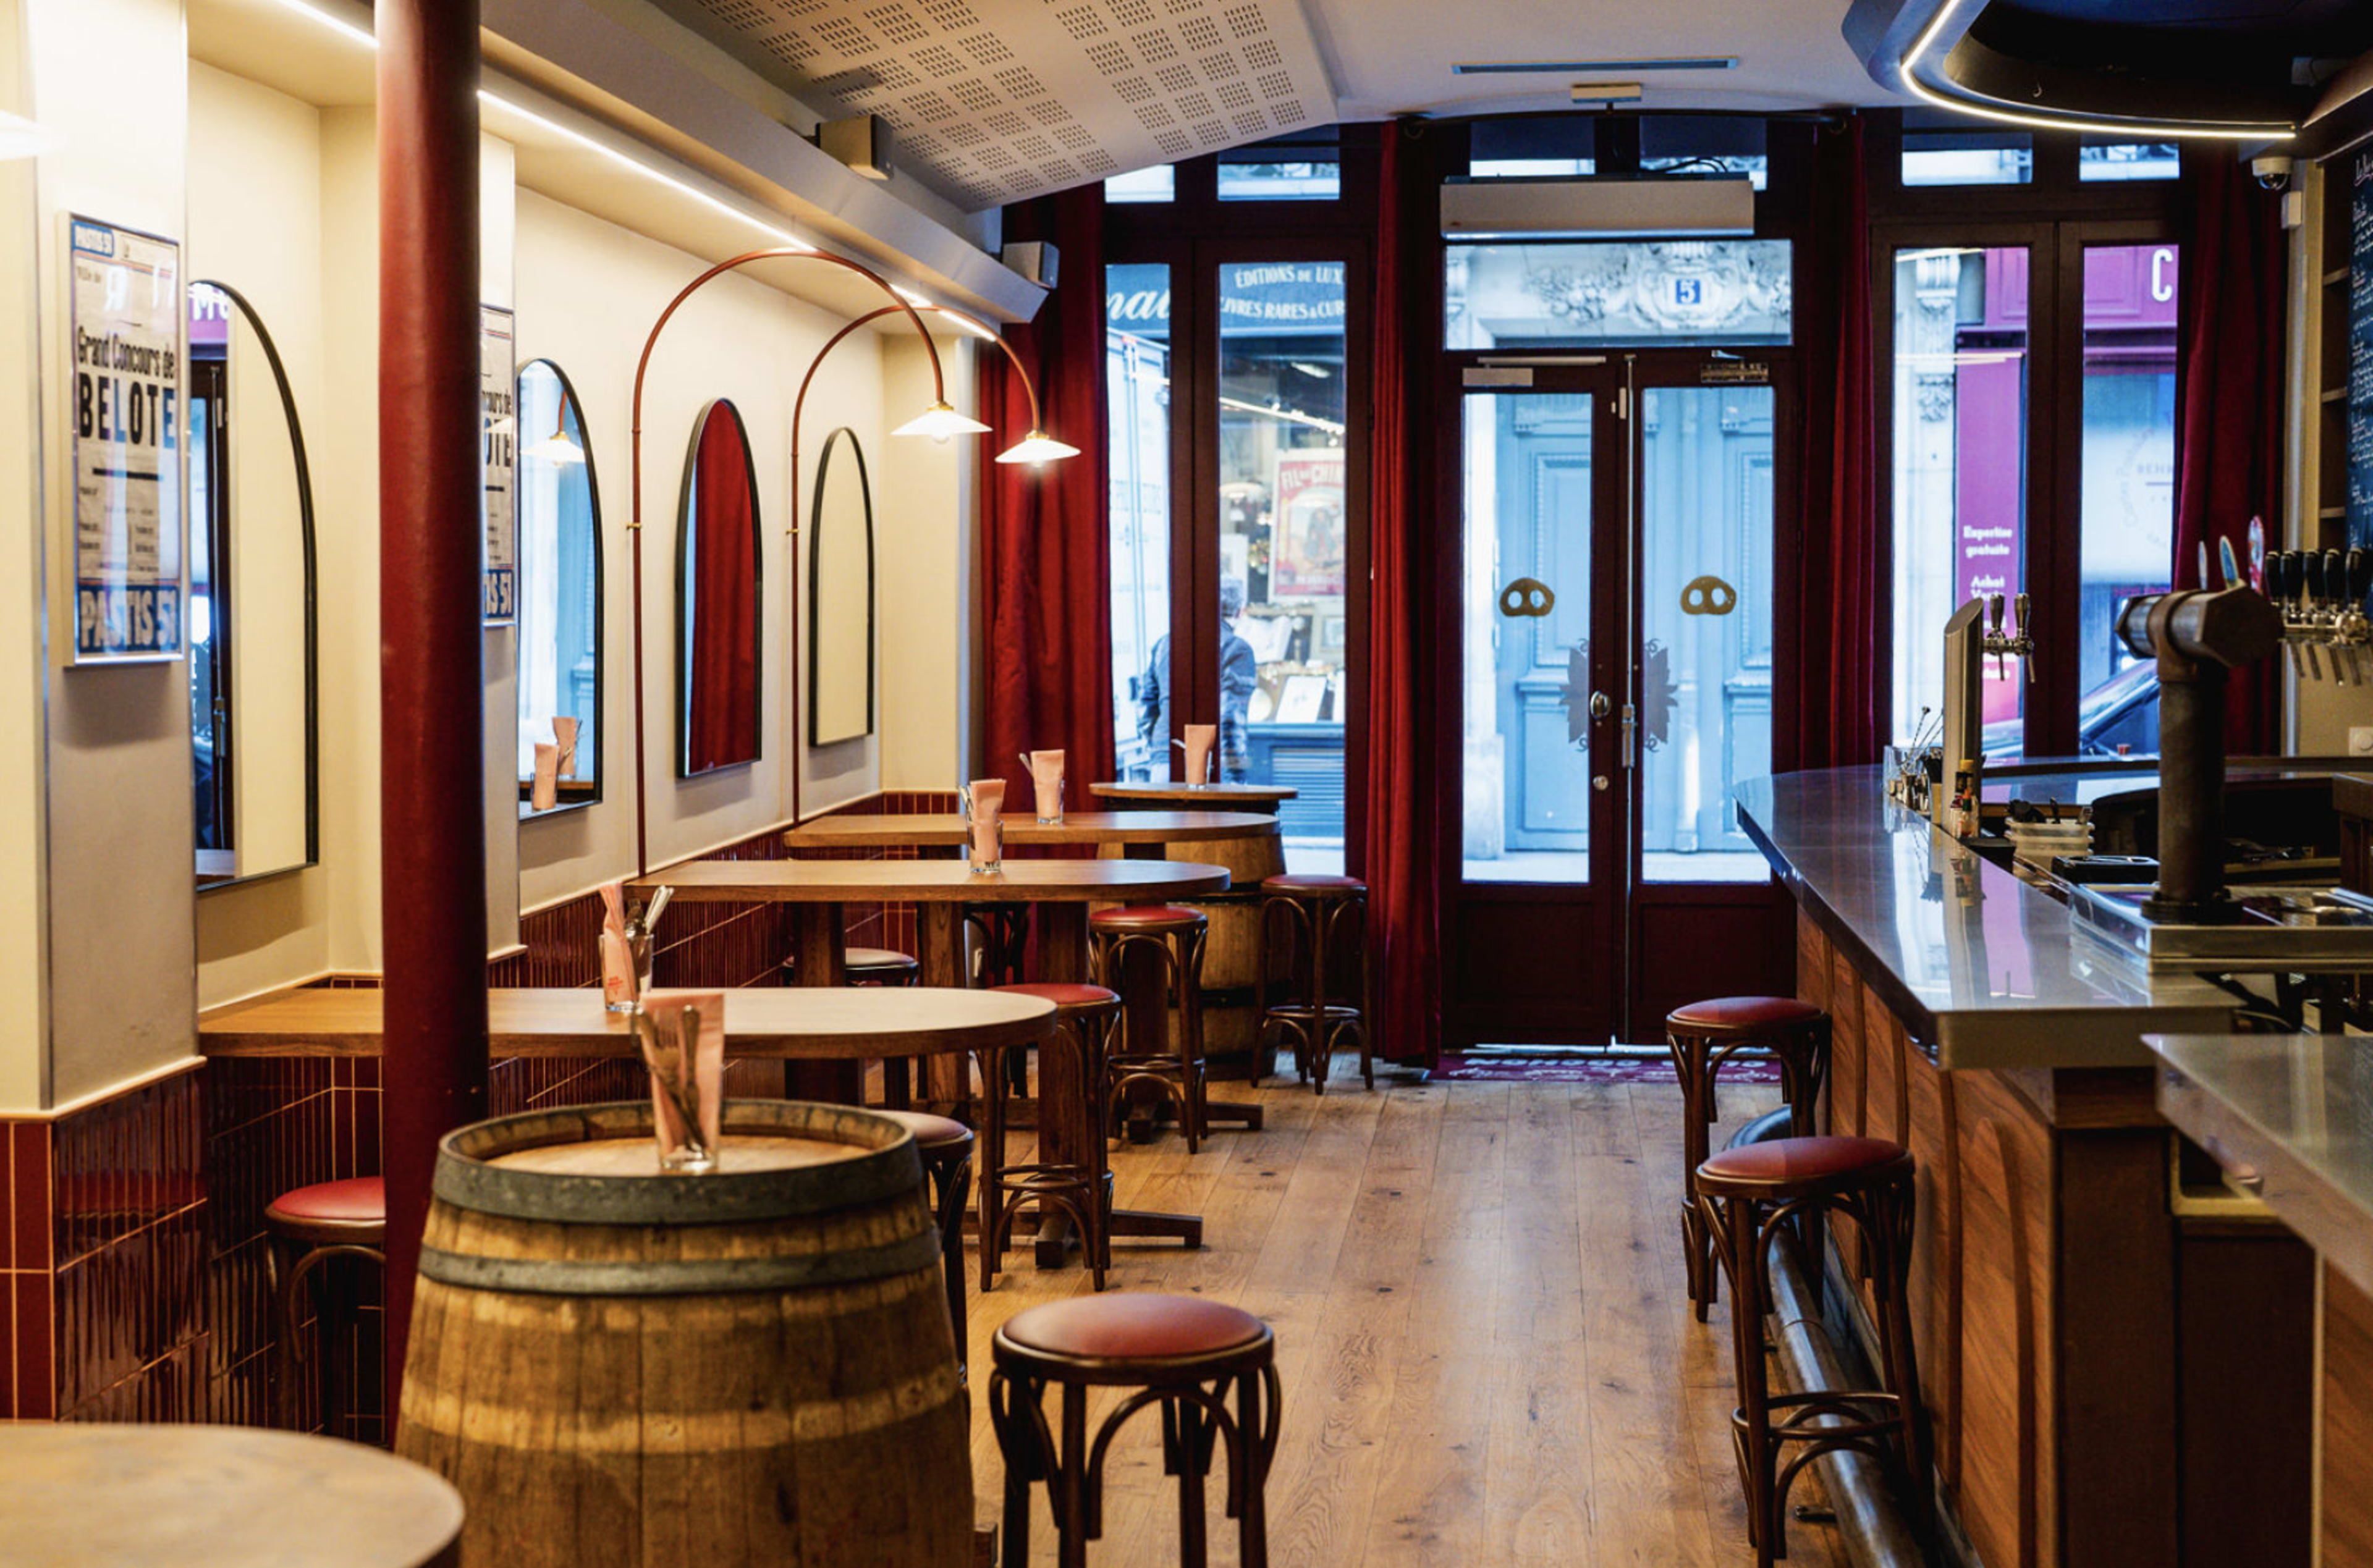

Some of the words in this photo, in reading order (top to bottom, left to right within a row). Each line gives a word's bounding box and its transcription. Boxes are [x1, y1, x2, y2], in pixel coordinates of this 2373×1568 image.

[2151, 248, 2173, 302] C
[1680, 280, 1697, 302] 5
[1264, 301, 1308, 319] RARES
[78, 326, 109, 368] Grand
[114, 332, 160, 377] Concours
[78, 372, 176, 449] BELOTE
[1964, 525, 2013, 541] Expertise
[1966, 543, 2010, 558] gratuite
[1971, 575, 2005, 588] Achat
[80, 589, 154, 648] PASTIS
[156, 589, 177, 648] 51
